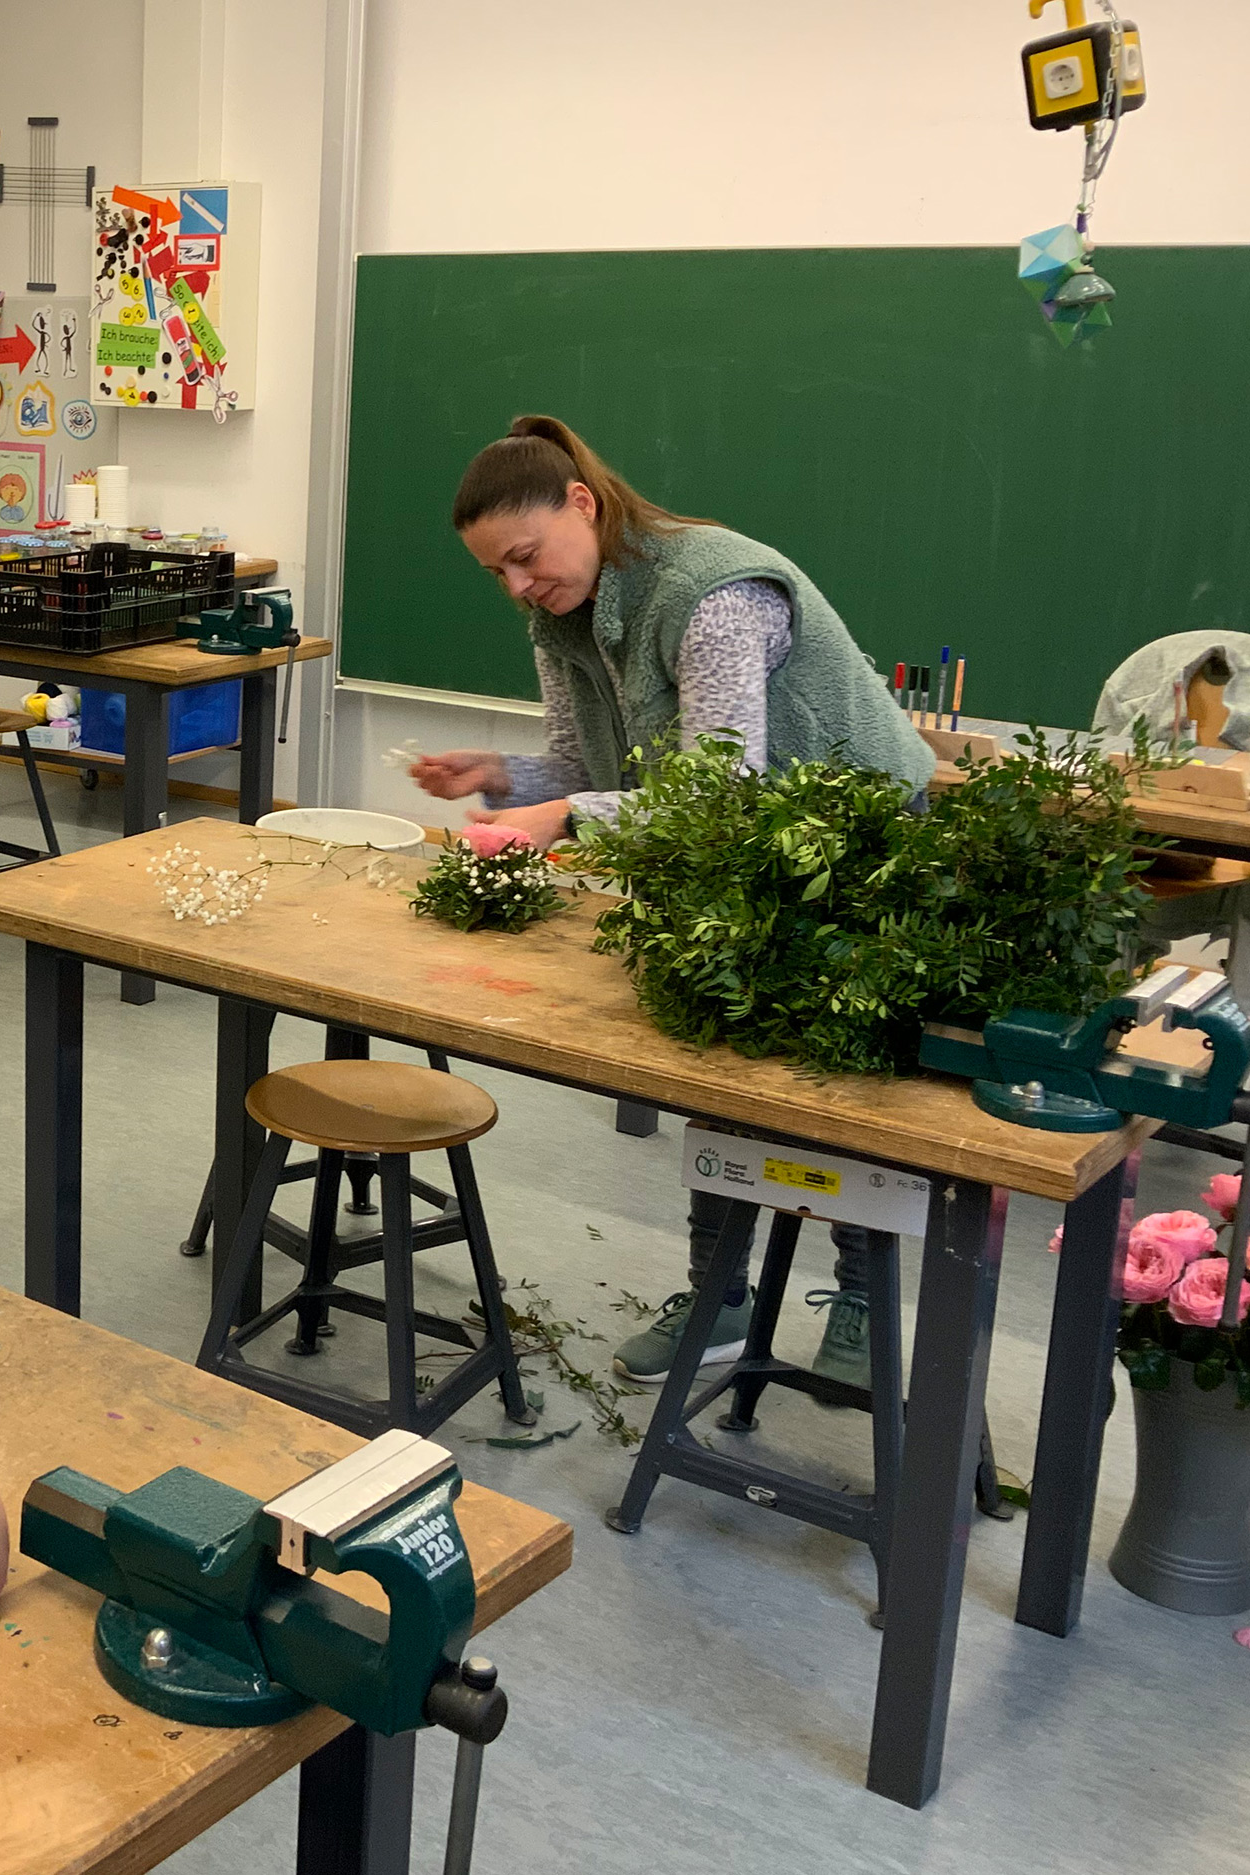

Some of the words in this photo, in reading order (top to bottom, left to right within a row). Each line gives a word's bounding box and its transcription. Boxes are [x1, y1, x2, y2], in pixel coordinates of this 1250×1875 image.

[122, 280, 129, 290] 5
[133, 285, 140, 294] 6
[173, 284, 185, 300] So
[101, 328, 117, 338] Ich
[98, 349, 111, 361] Ich
[395, 1514, 449, 1555] Junior
[419, 1534, 455, 1566] 120
